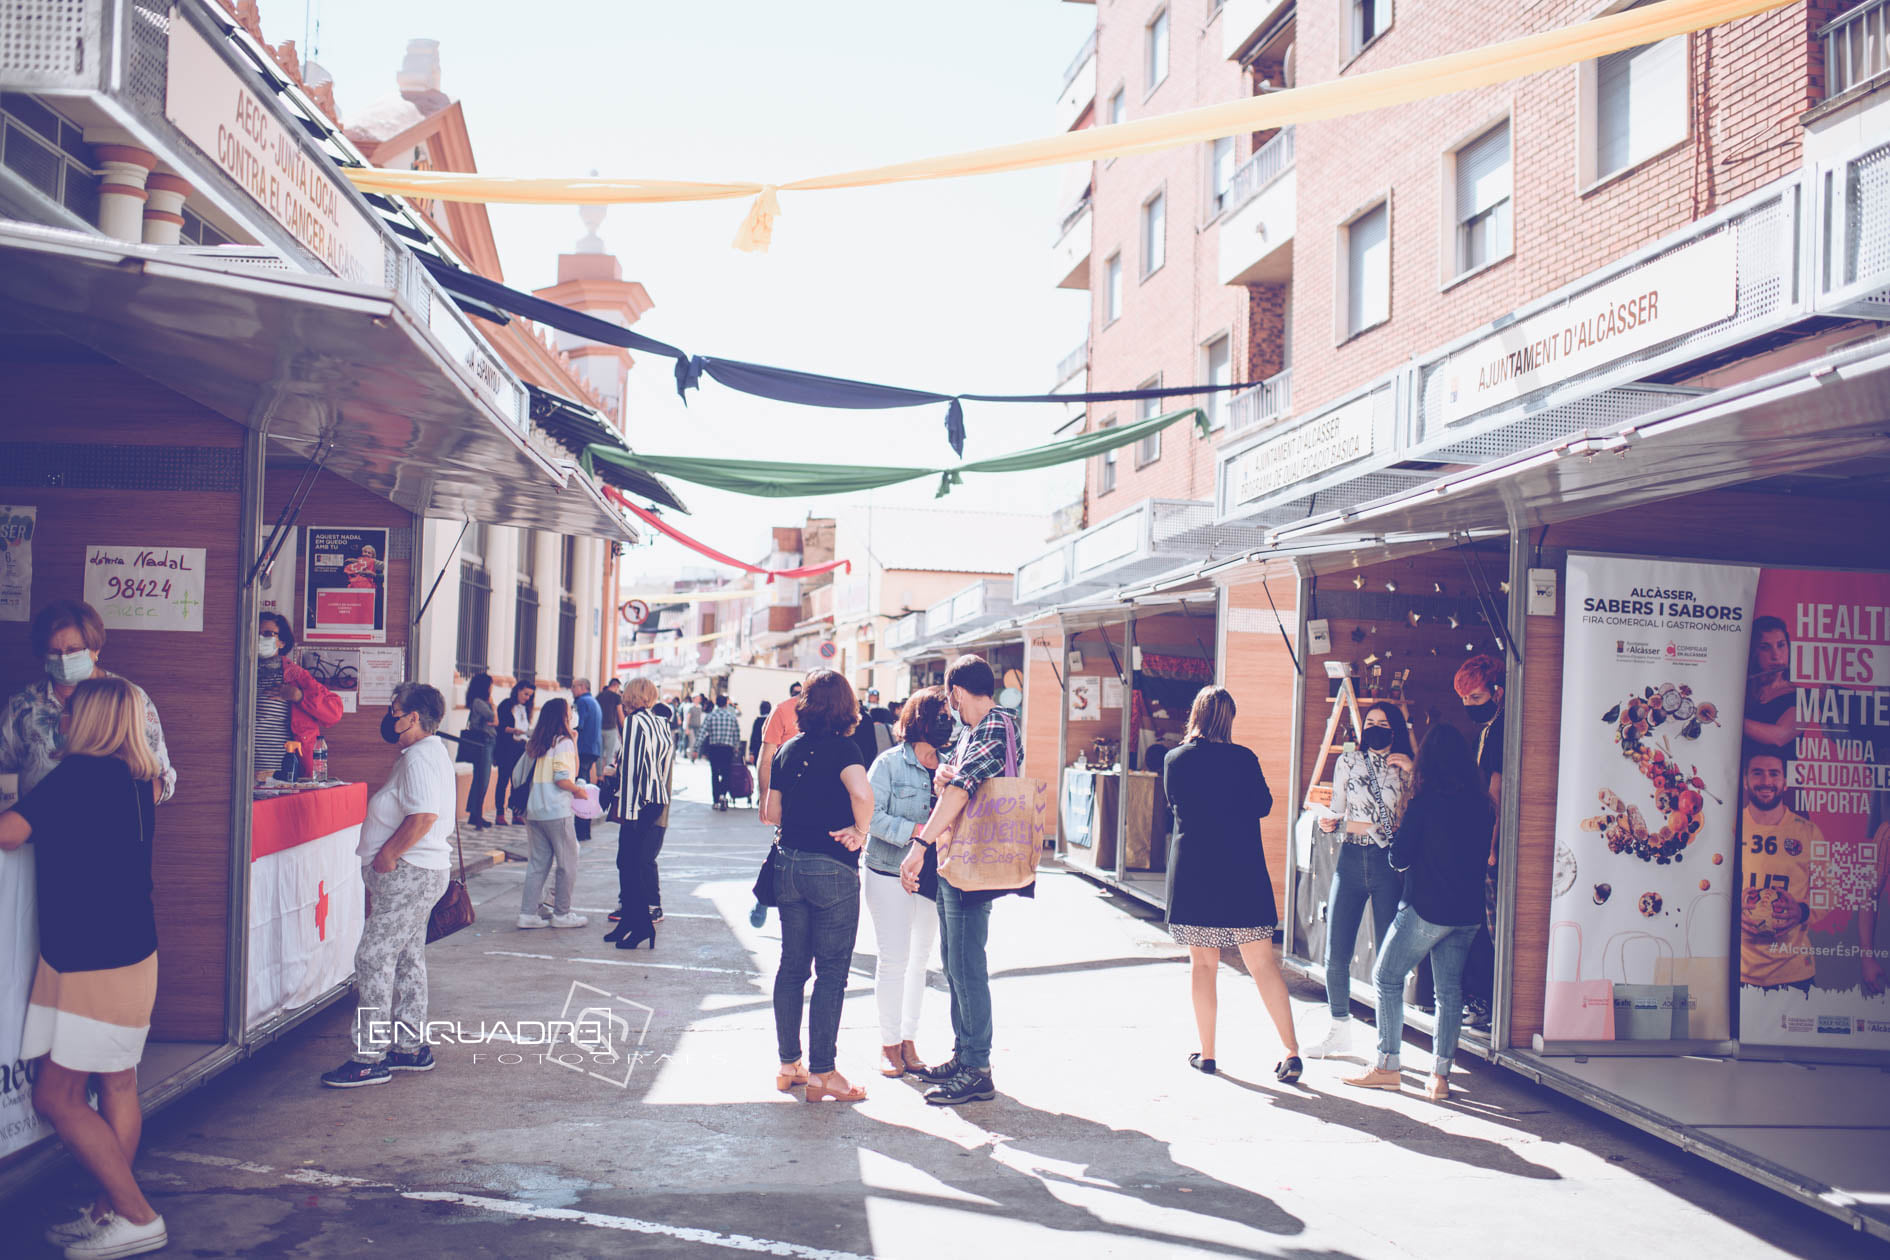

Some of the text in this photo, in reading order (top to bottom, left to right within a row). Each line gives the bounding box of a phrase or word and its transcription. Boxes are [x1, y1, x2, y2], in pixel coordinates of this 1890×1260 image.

[217, 123, 267, 205] CONTRA
[270, 174, 282, 219] EL
[235, 88, 268, 152] AECC
[309, 168, 340, 228] LOCAL
[1477, 290, 1659, 393] AJUNTAMENT D'ALCÀSSER
[1255, 437, 1297, 472] AJUNTAMENT
[104, 575, 172, 601] 98424
[1630, 586, 1697, 602] ALCÀSSER,
[1583, 597, 1743, 621] SABERS I SABORS
[1582, 615, 1603, 625] FIRA
[1606, 616, 1660, 628] COMERCIAL
[1666, 620, 1742, 633] GASTRONÒMICA
[1796, 644, 1874, 684] LIVES
[1795, 736, 1875, 762] UNA VIDA
[1794, 789, 1871, 814] IMPORTA
[1750, 834, 1778, 856] 36
